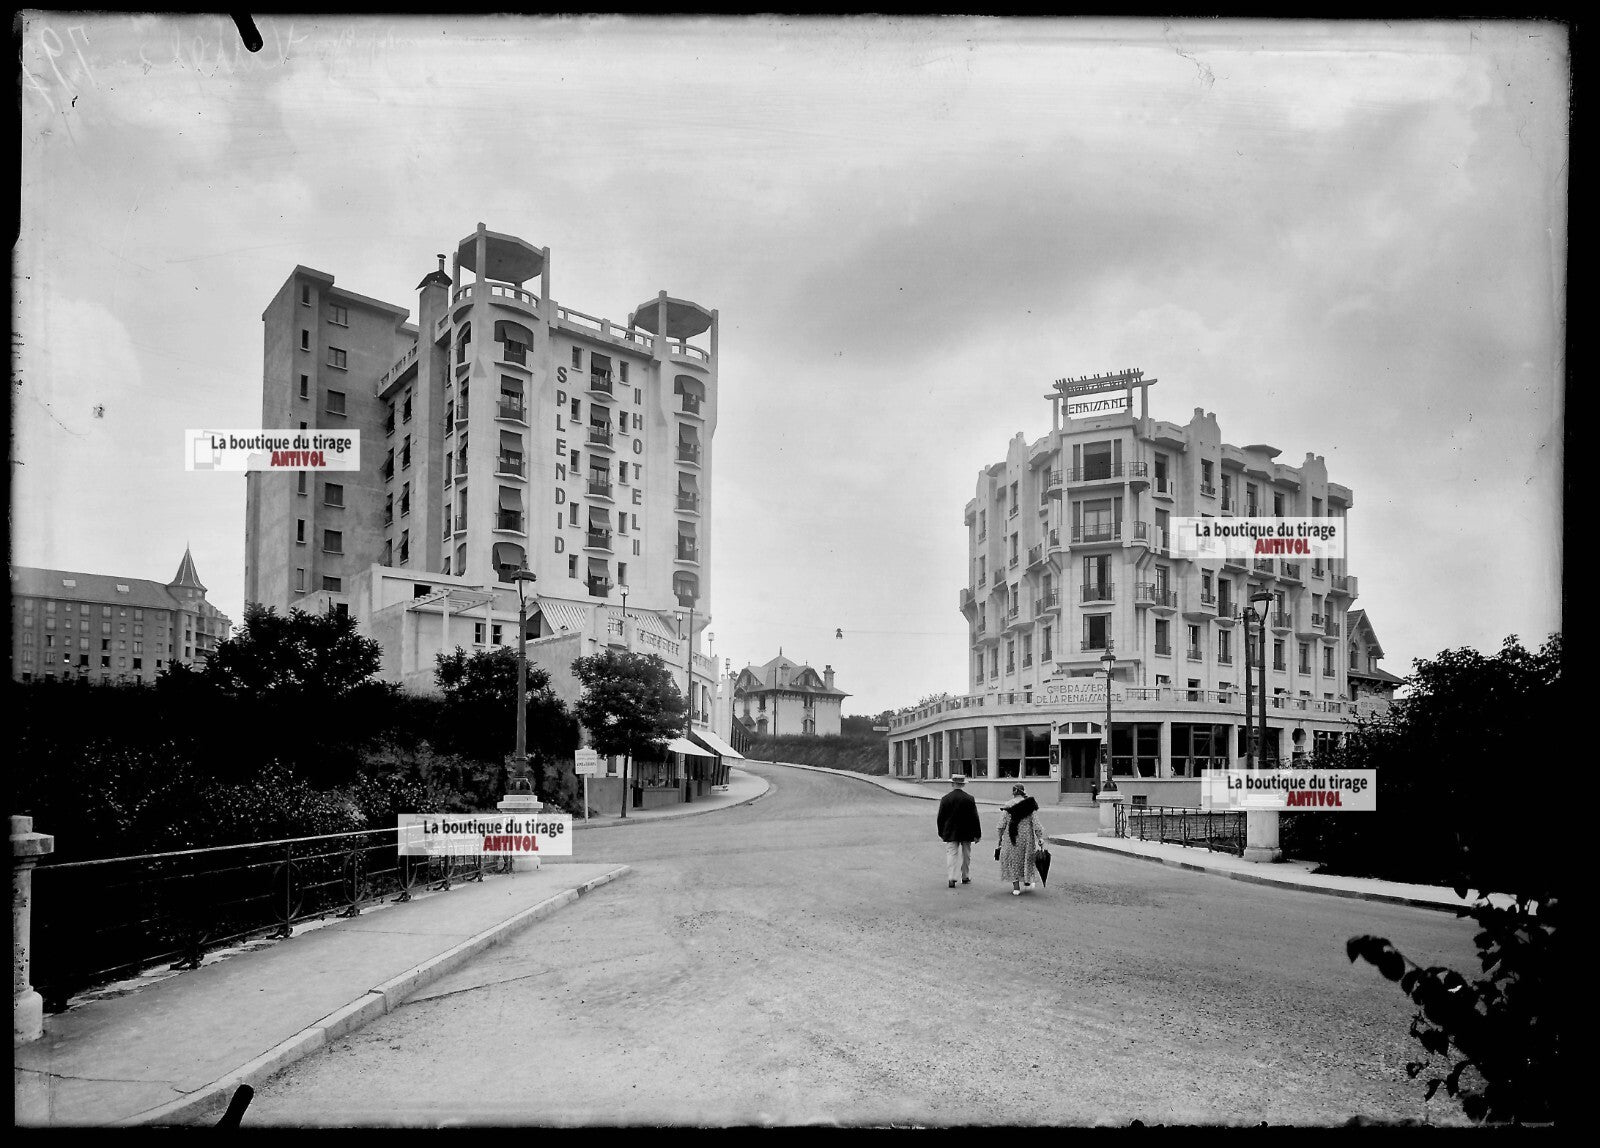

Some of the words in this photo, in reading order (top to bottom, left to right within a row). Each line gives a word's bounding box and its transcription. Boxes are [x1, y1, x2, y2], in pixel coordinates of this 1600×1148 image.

[1062, 396, 1133, 415] ENAISSANC
[554, 366, 568, 554] SPLENDID
[632, 412, 643, 531] HOTEL
[1060, 684, 1108, 694] BRASSERI
[1036, 695, 1048, 704] DE
[1049, 695, 1059, 704] LA
